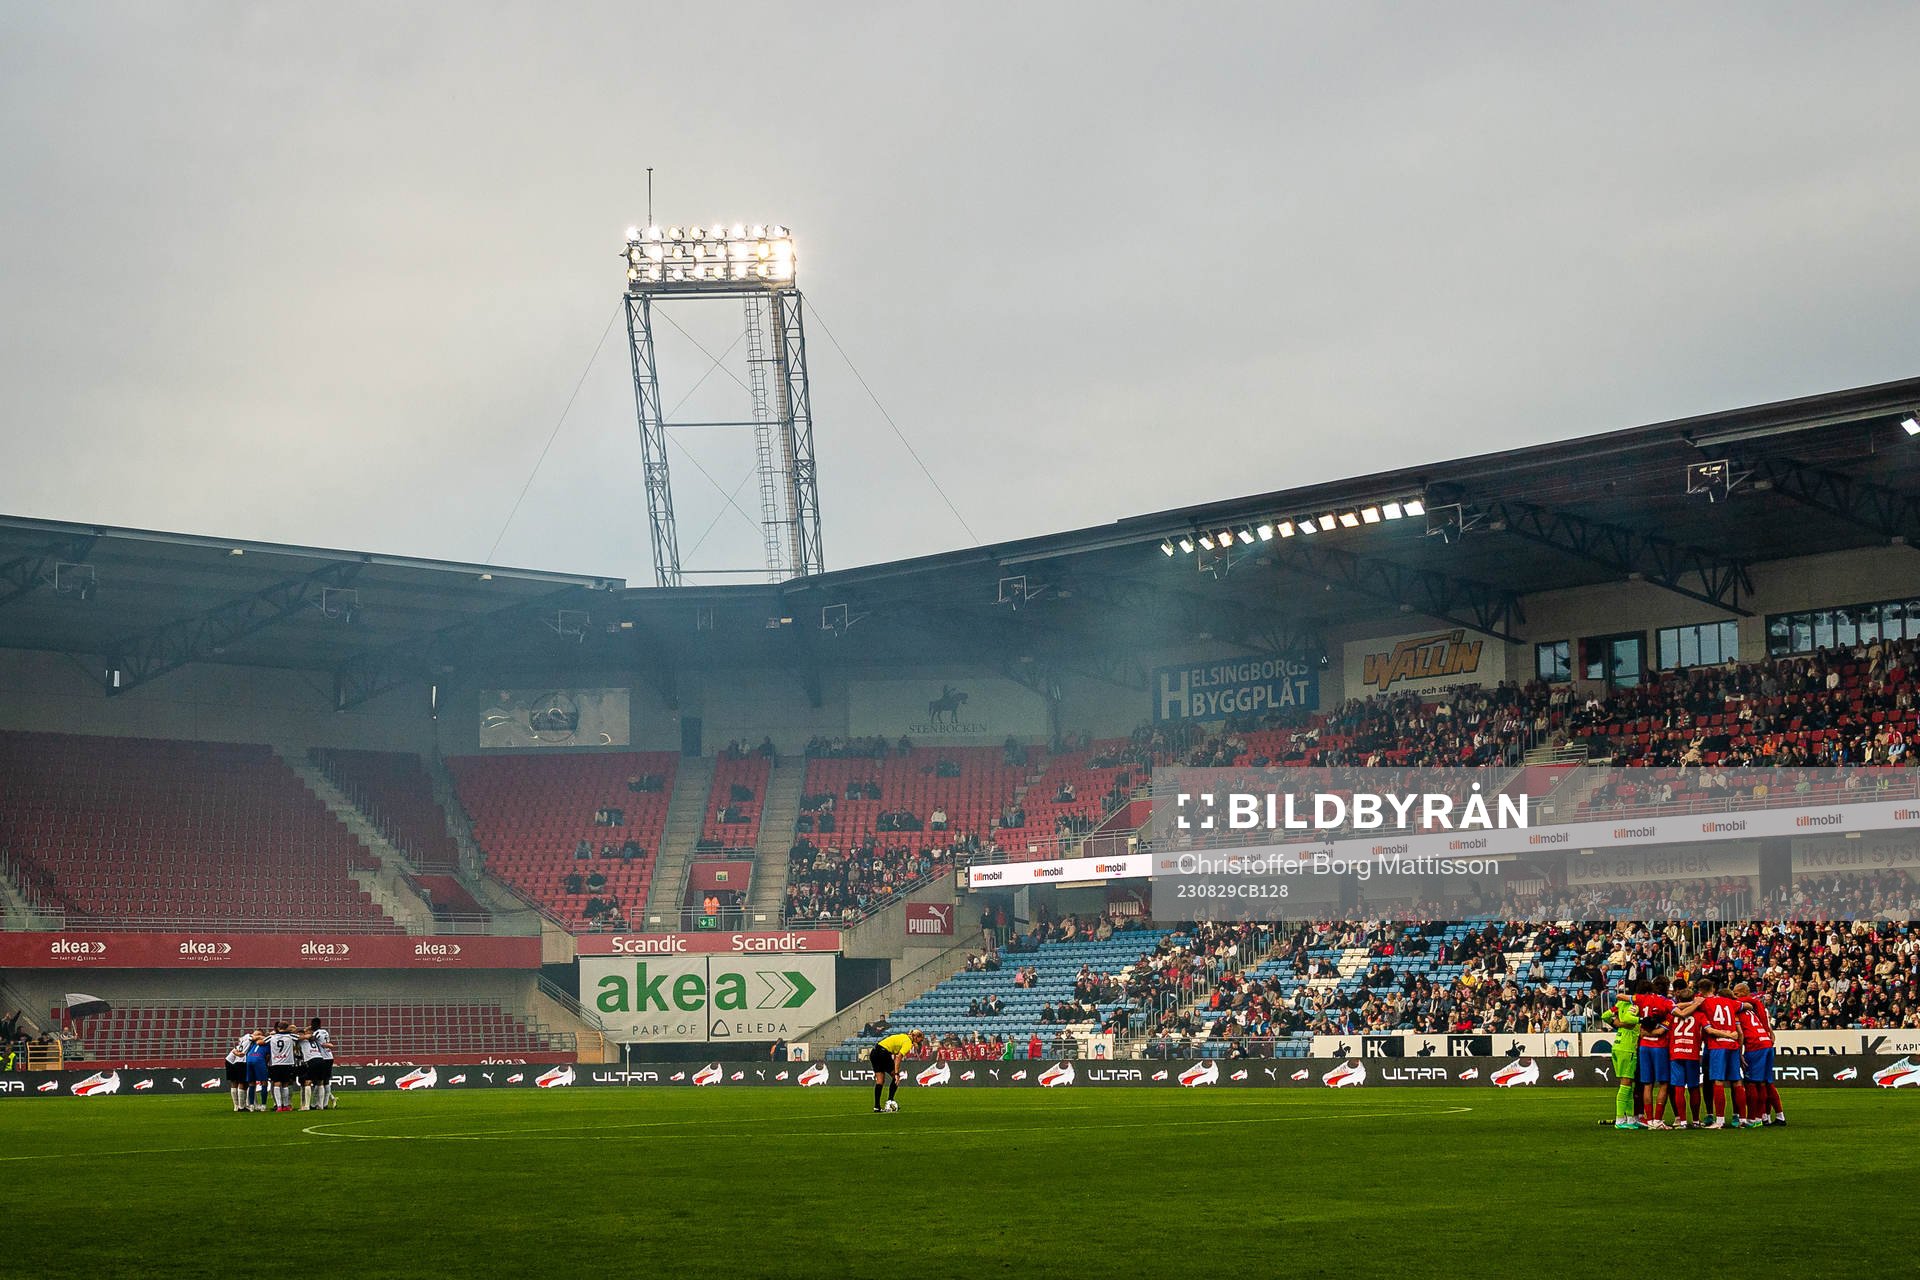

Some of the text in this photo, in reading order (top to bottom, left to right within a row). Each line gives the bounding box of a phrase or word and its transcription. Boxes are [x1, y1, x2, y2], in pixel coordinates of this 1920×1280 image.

[1363, 630, 1483, 691] WALLIN
[1192, 677, 1310, 717] BYGGPLÅT
[1421, 686, 1437, 695] och
[1702, 820, 1746, 832] tillmobil
[1796, 813, 1842, 826] tillmobil
[1529, 832, 1568, 844] tillmobil
[1614, 826, 1655, 839] tillmobil
[1372, 844, 1408, 855] tillmobil
[1449, 838, 1487, 850] tillmobil
[1033, 867, 1063, 877] tillmobil
[1096, 862, 1126, 873] tillmobil
[974, 872, 1002, 881] tillmobil
[909, 919, 941, 933] PUMA
[51, 939, 89, 953] akea
[180, 940, 216, 954] akea
[301, 940, 334, 954] akea
[415, 941, 447, 955] akea
[612, 935, 686, 953] Scandic
[732, 933, 806, 950] Scandic
[596, 962, 748, 1013] akea
[1713, 1004, 1732, 1026] 41
[632, 1023, 788, 1035] PART OF ELEDA
[1673, 1016, 1695, 1037] 22
[277, 1040, 285, 1053] 9
[593, 1071, 658, 1082] ULTRA
[840, 1070, 878, 1081] ULTR
[1088, 1069, 1142, 1081] ULTRA
[1382, 1068, 1447, 1080] ULTRA
